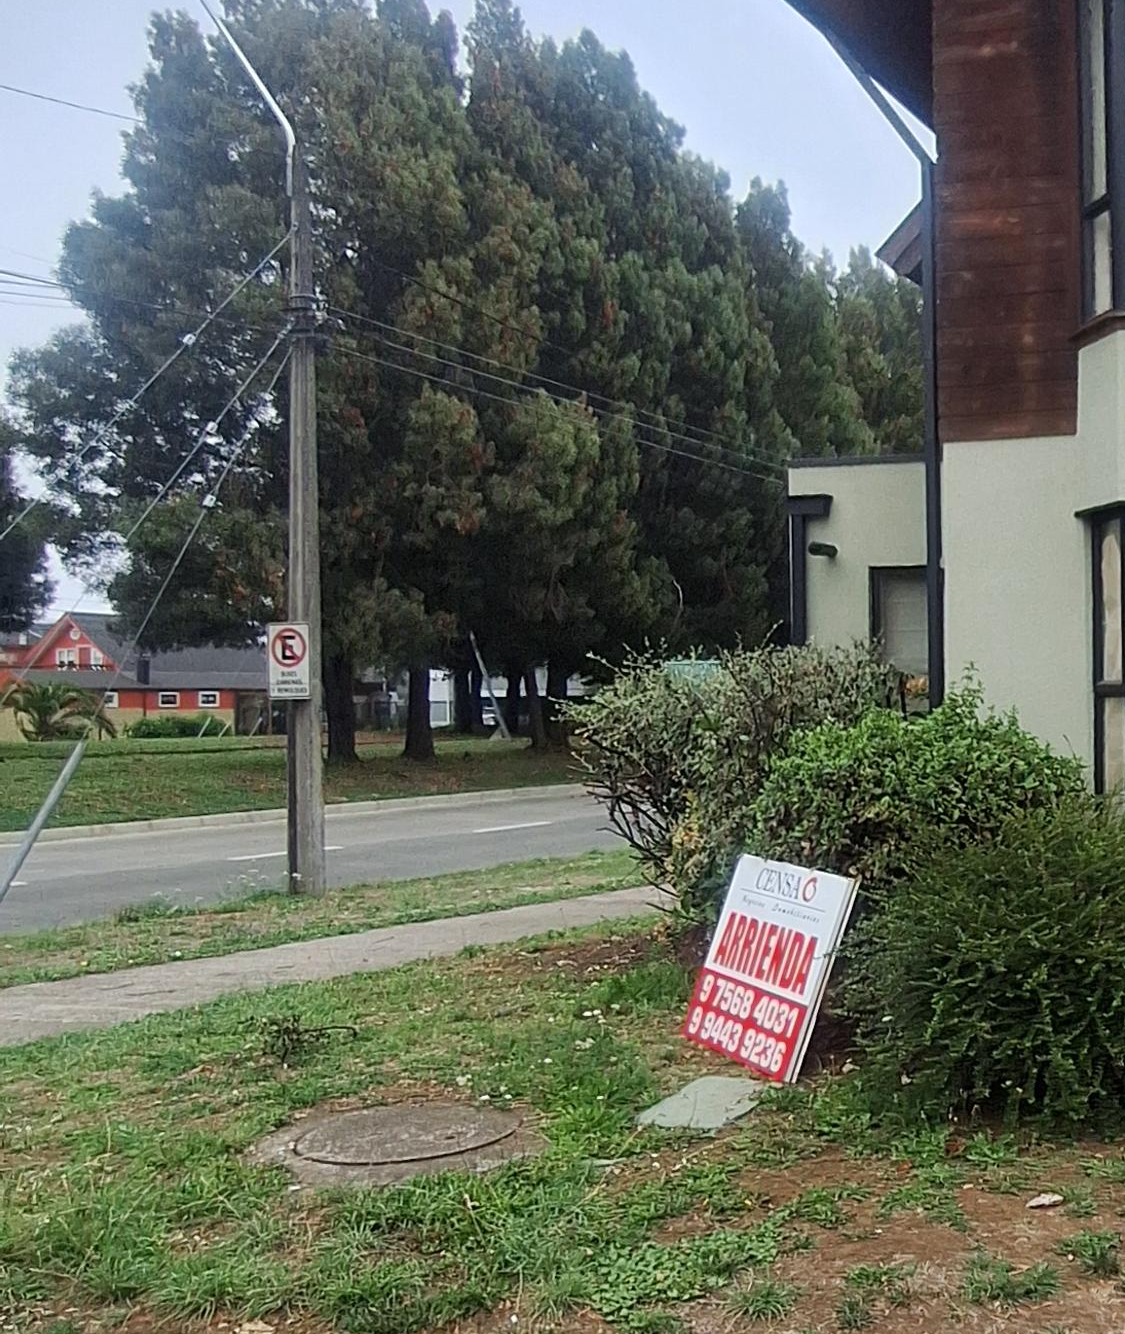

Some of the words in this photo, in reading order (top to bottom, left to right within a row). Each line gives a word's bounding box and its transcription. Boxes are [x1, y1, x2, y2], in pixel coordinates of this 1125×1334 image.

[281, 635, 296, 660] E
[713, 911, 819, 996] ARRIENDA
[700, 974, 714, 1002] 9
[712, 979, 754, 1019] 7568
[753, 996, 797, 1038] 4031
[688, 1007, 703, 1034] 9
[700, 1013, 743, 1053] 9443
[740, 1028, 787, 1072] 9236
